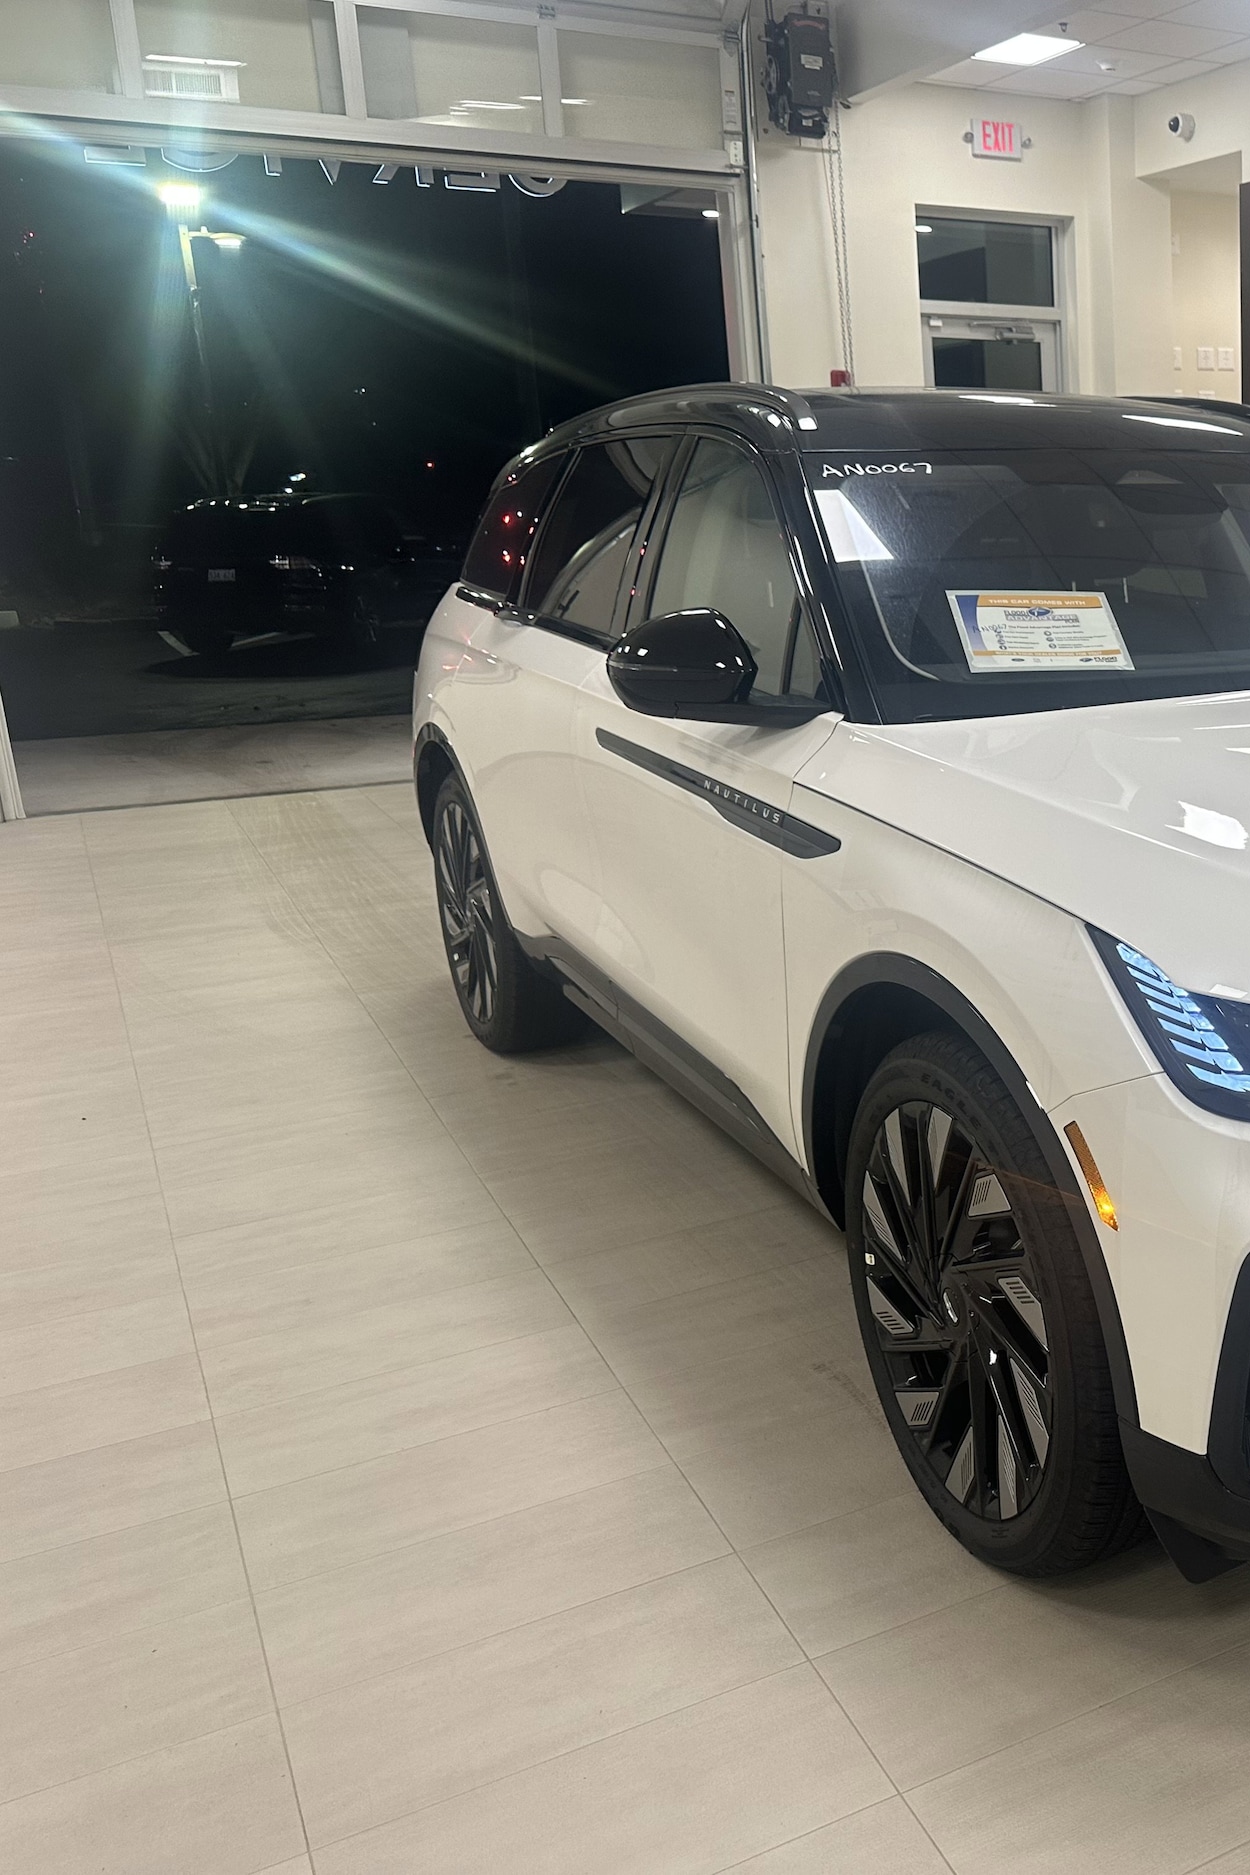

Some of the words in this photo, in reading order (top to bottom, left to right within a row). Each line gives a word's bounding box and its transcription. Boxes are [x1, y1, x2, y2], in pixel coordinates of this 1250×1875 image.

[982, 120, 1014, 153] EXIT
[822, 463, 932, 478] AN0067
[704, 780, 780, 823] NAUTILUS
[920, 1072, 982, 1128] EAGLE
